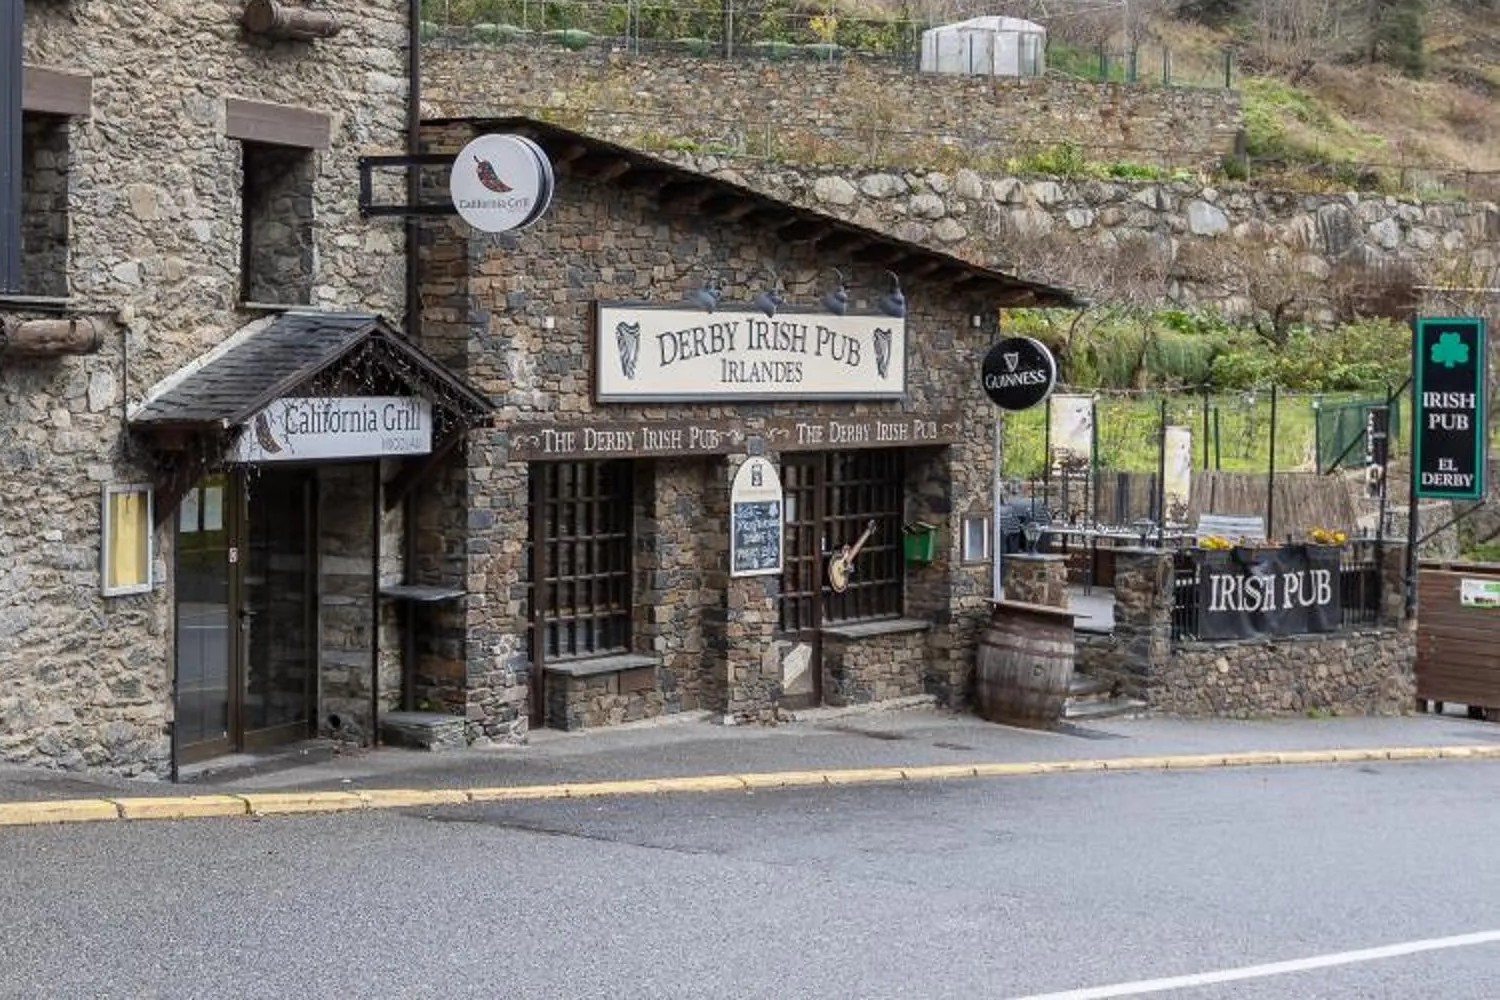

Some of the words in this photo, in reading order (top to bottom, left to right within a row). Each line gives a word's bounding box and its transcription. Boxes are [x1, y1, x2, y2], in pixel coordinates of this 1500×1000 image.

[656, 321, 739, 367] DERBY
[747, 318, 808, 353] IRISH
[815, 324, 861, 367] PUB
[721, 358, 804, 383] IRLANDES
[985, 369, 1047, 389] GUINNESS
[1423, 391, 1476, 409] IRISH
[285, 403, 378, 435] California
[383, 402, 421, 432] Grill
[1428, 413, 1469, 431] PUB
[542, 428, 576, 452] THE
[584, 427, 635, 450] DERBY
[642, 427, 682, 449] IRISH
[689, 426, 720, 450] PUB
[796, 423, 824, 445] THE
[829, 421, 871, 442] DERBY
[876, 420, 909, 441] IRISH
[913, 419, 938, 439] PUB
[1438, 458, 1458, 472] EL
[1421, 472, 1474, 487] DERBY
[1208, 574, 1277, 611] IRISH
[1283, 569, 1332, 609] PUB
